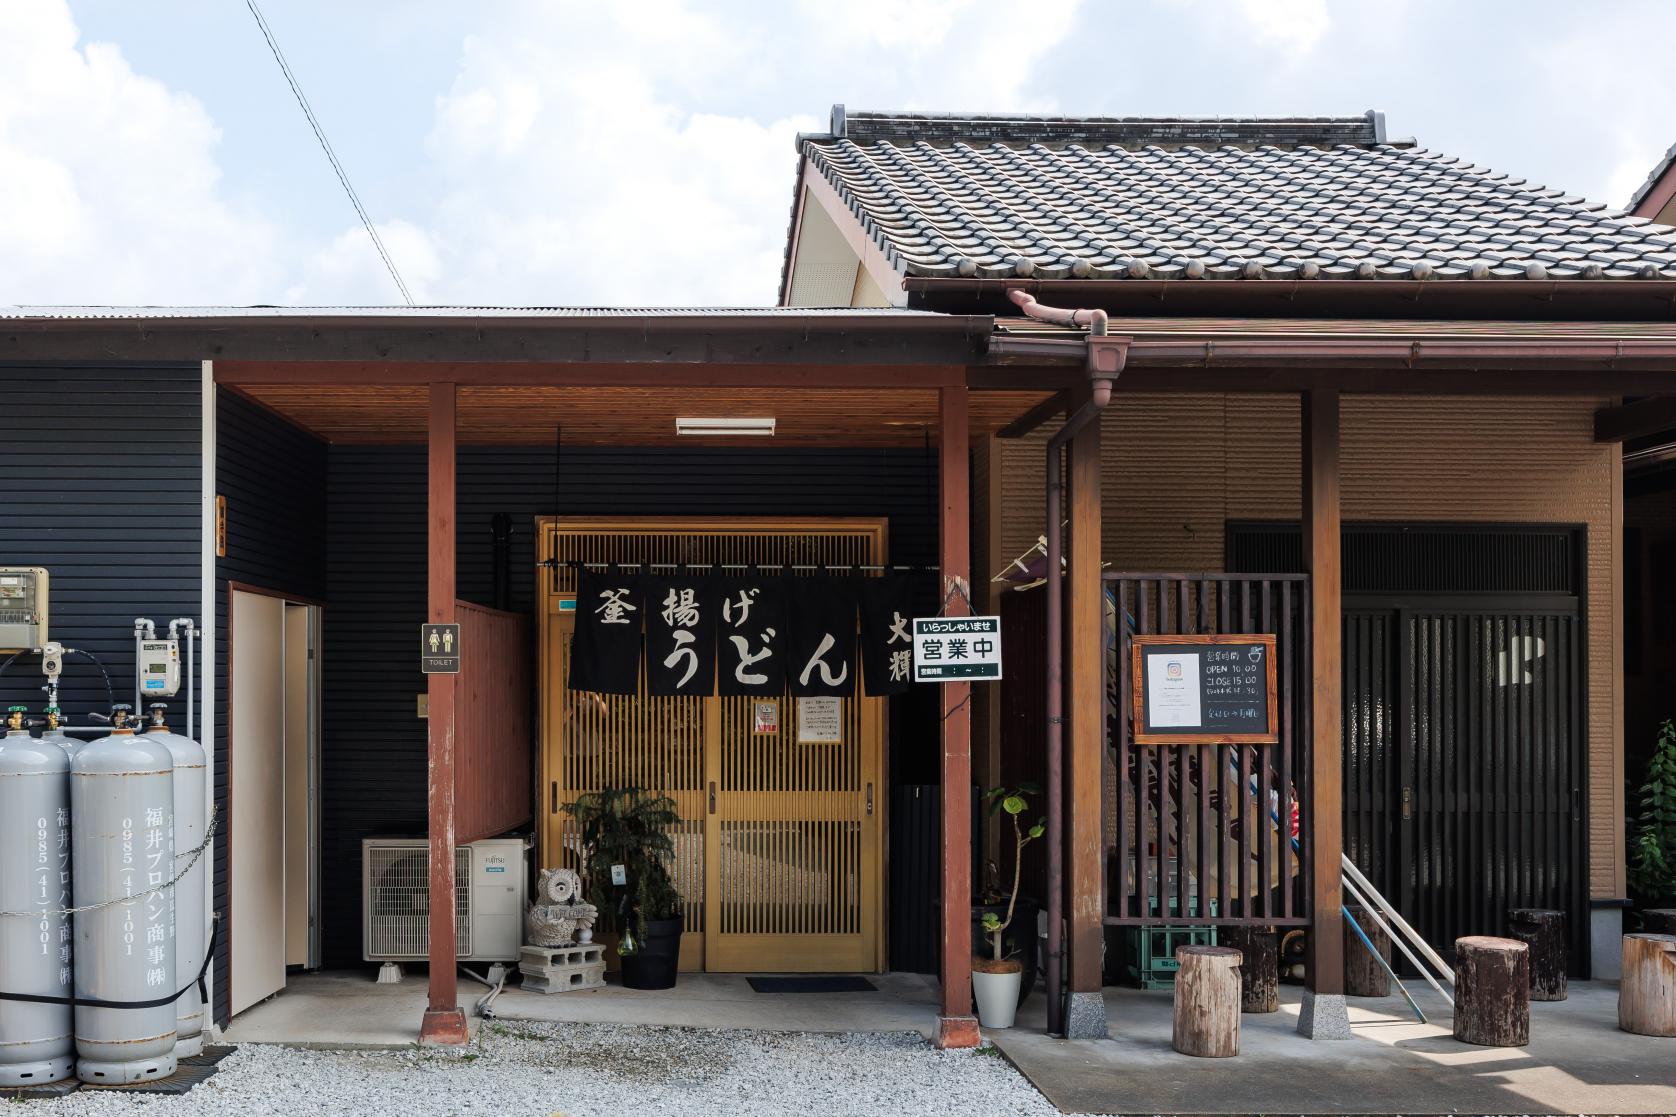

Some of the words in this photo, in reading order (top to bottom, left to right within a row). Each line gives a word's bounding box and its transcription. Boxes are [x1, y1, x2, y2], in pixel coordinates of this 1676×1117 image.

[922, 621, 991, 632] いらっしゃいませ
[922, 637, 993, 660] 営業中
[663, 628, 848, 689] うどん
[1206, 665, 1228, 674] OPEN
[1206, 677, 1232, 686] CLOSE
